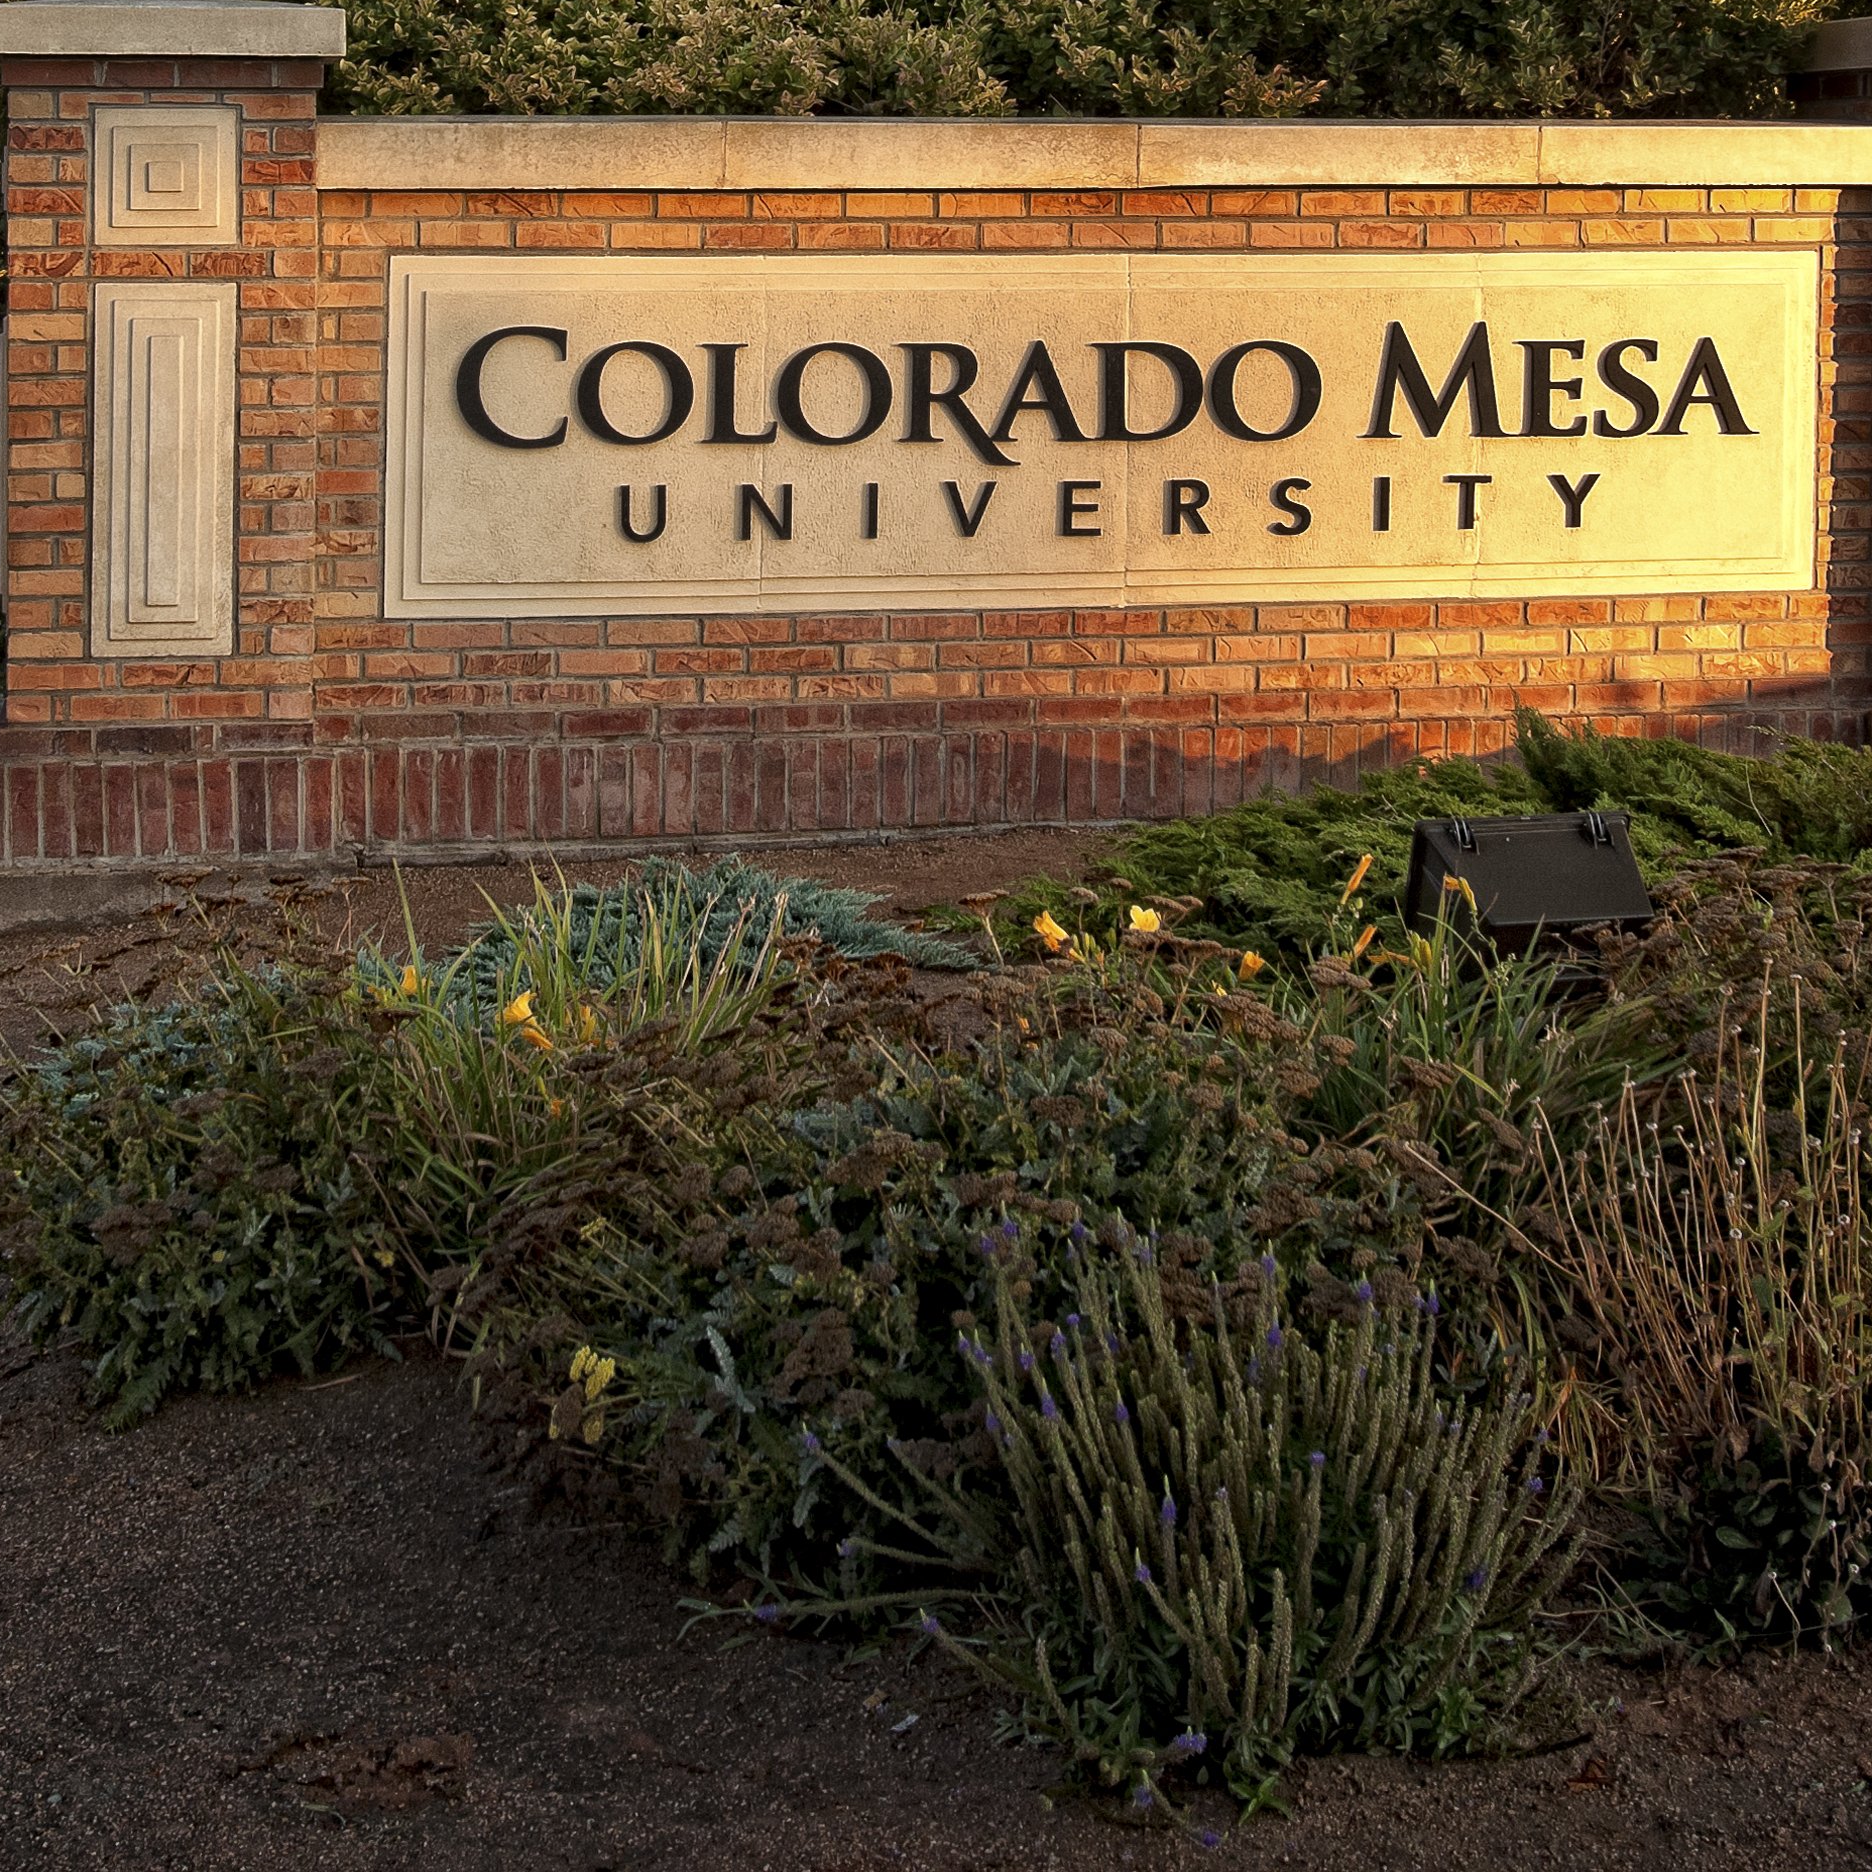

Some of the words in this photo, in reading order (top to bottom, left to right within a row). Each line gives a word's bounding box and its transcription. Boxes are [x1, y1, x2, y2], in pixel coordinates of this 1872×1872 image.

[454, 325, 1321, 465] COLORADO
[1357, 321, 1760, 438] MESA
[617, 474, 1601, 544] UNIVERSITY
